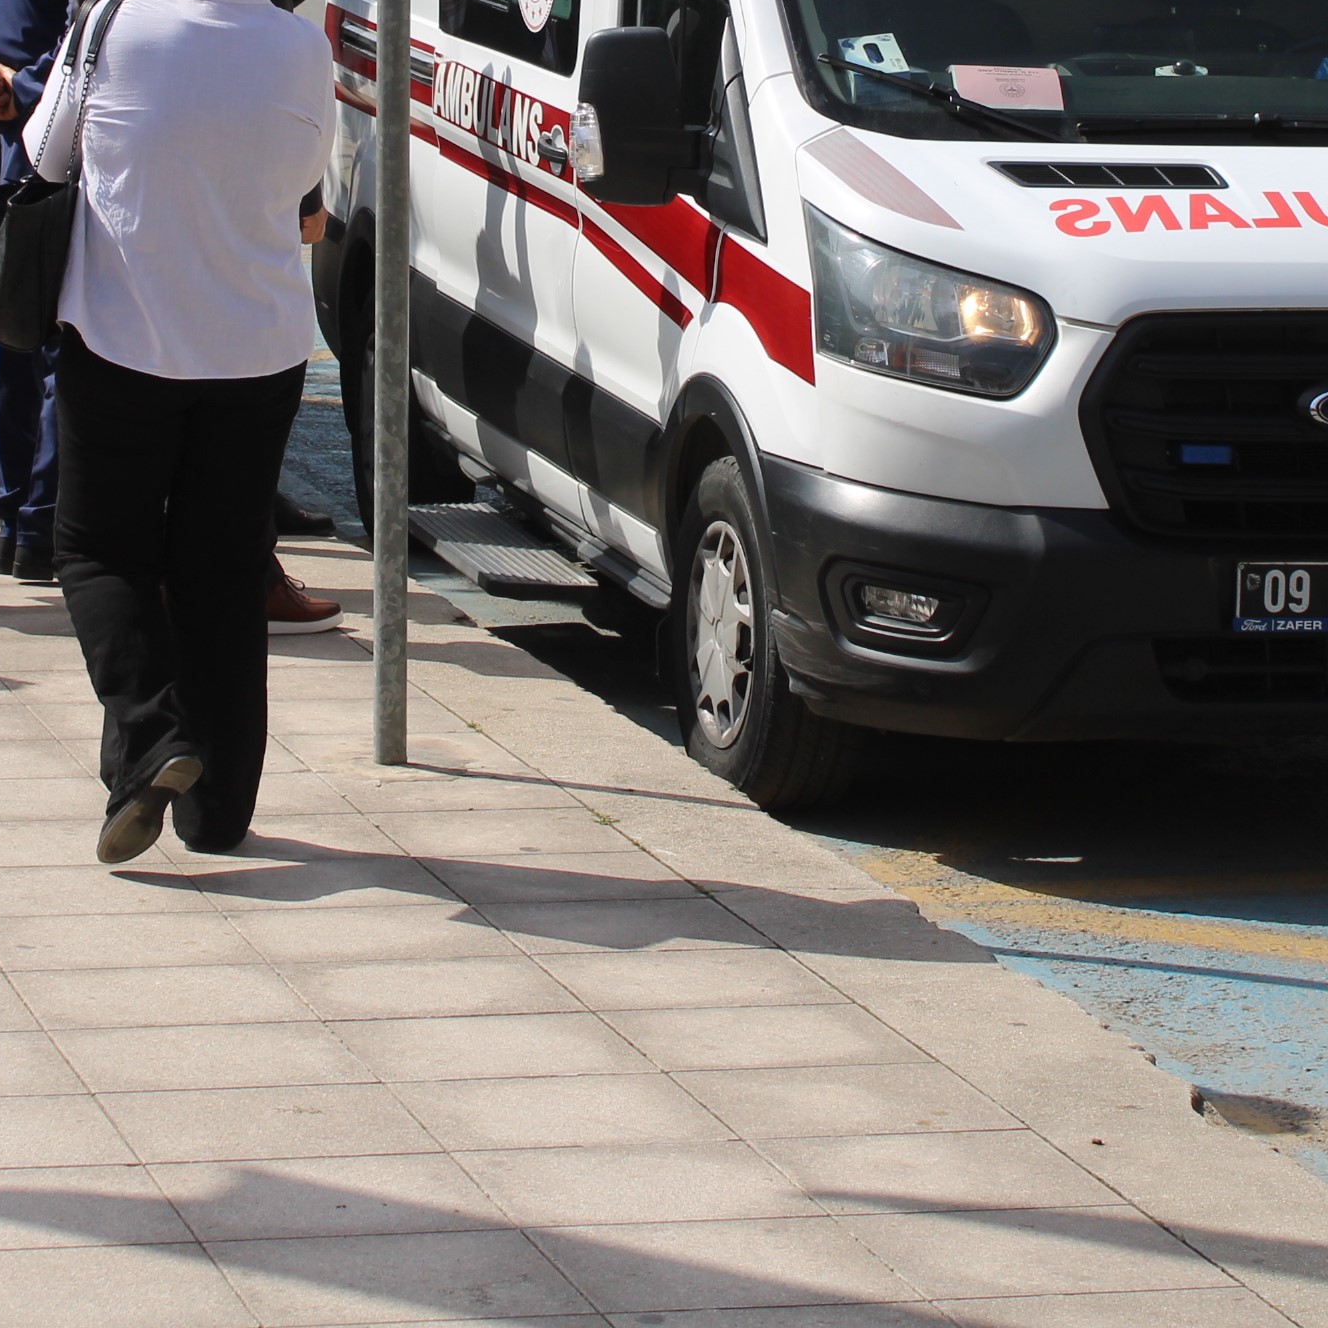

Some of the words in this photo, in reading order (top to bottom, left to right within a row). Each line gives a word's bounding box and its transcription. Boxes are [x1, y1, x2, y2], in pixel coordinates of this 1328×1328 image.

[433, 62, 544, 167] AMBULANS
[1264, 569, 1311, 613] 09
[1241, 619, 1268, 631] Ford
[1276, 620, 1322, 630] ZAFER
